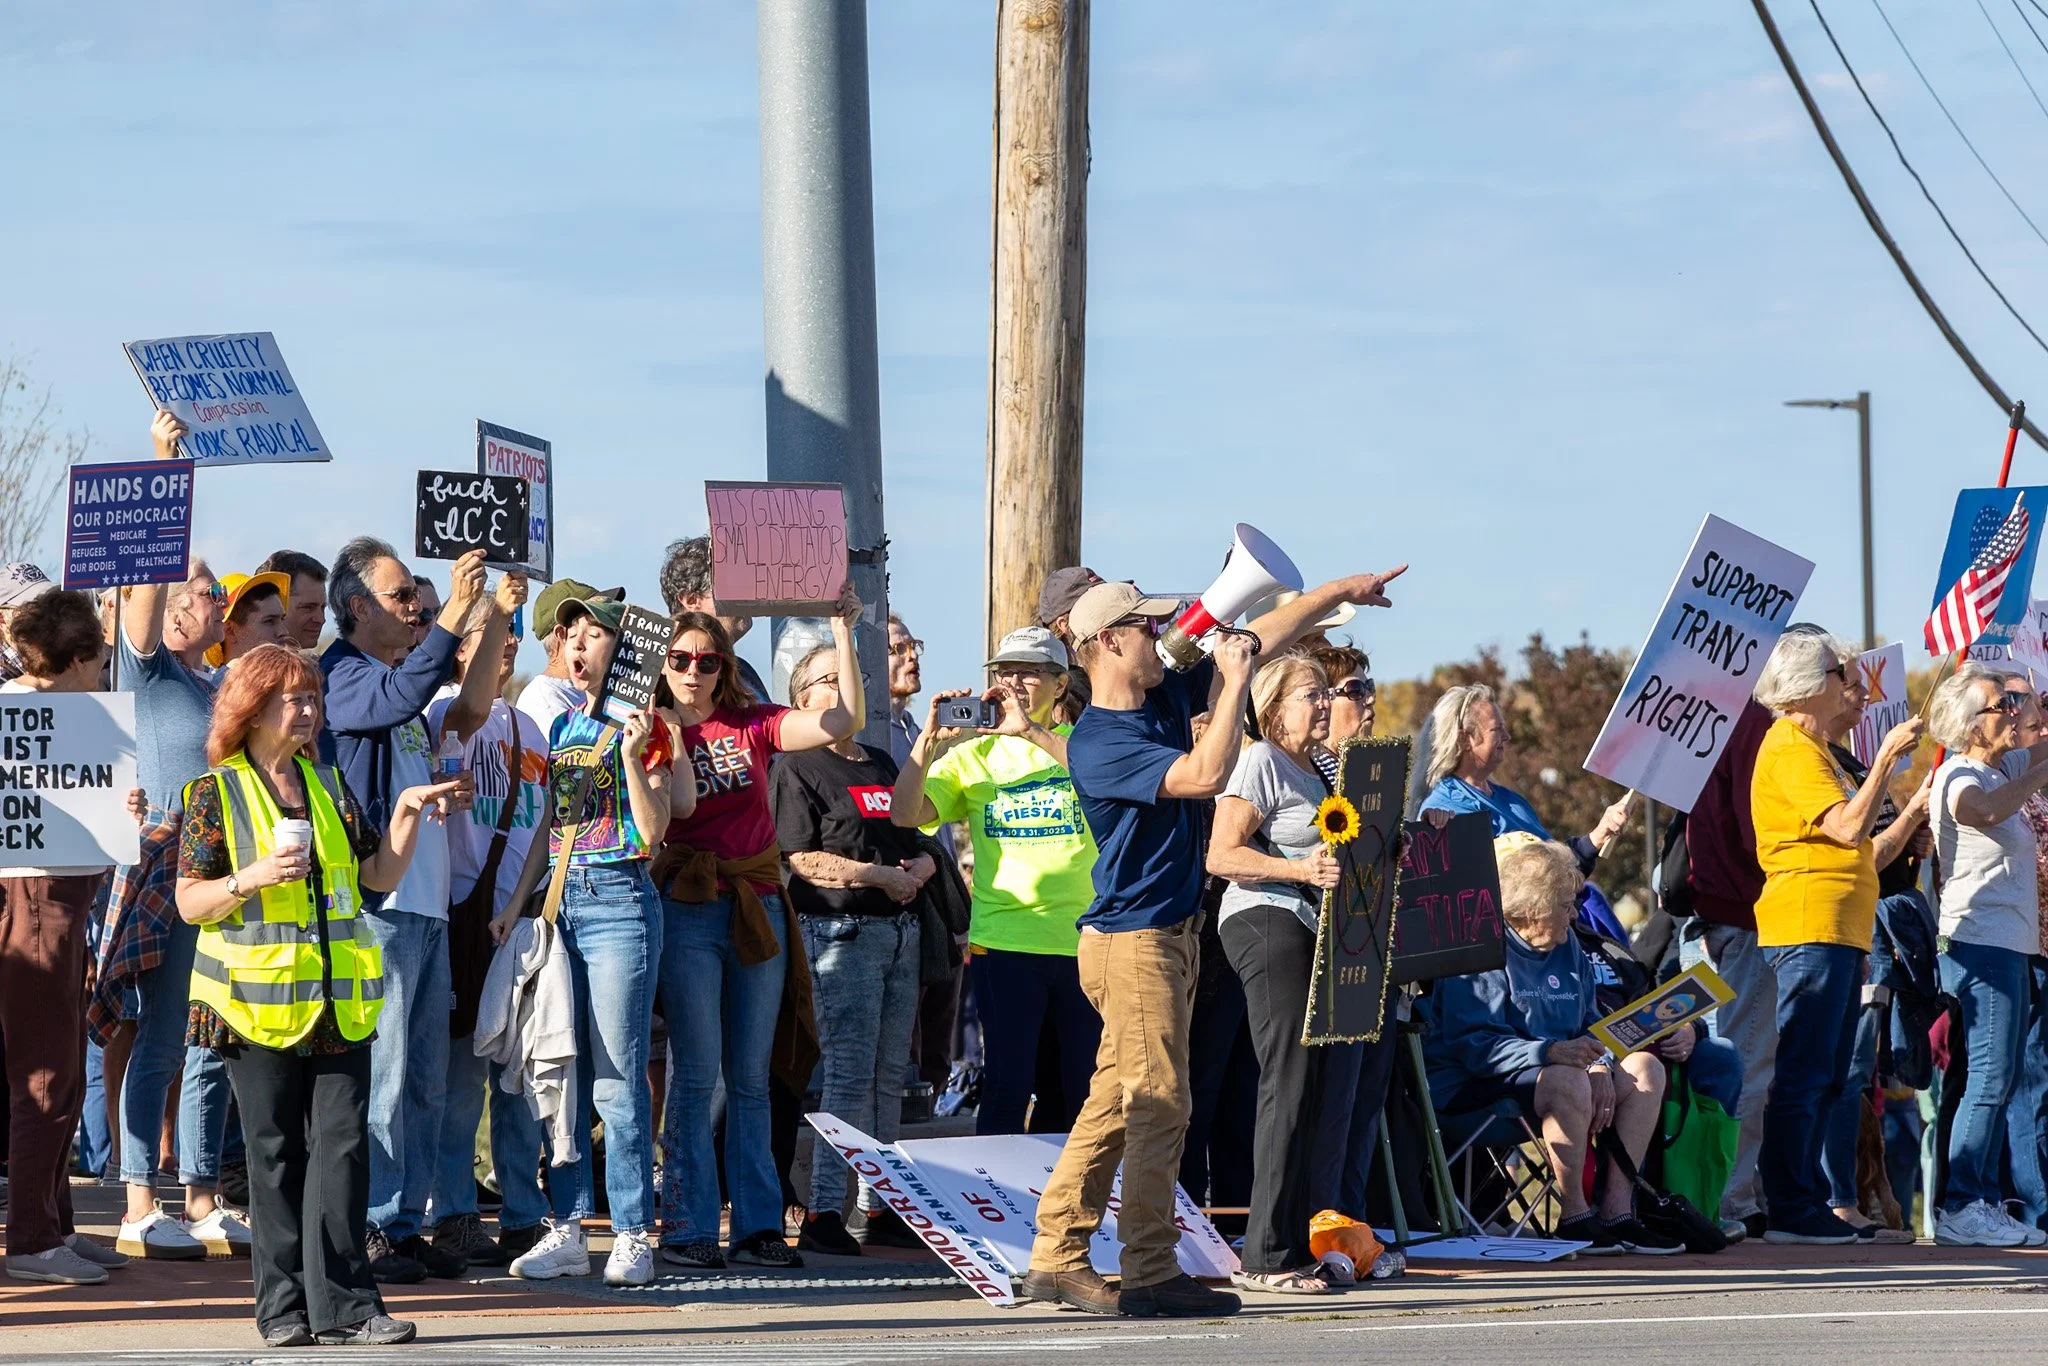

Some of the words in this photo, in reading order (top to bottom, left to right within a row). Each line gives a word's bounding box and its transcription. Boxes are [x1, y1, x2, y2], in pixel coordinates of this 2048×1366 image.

[131, 342, 186, 372] WHEN
[186, 336, 266, 372] CRUELTY
[148, 372, 227, 403] BECOMES
[225, 369, 293, 397] NORMAL
[193, 398, 270, 423] Compassion
[180, 428, 239, 458] LOOKS
[237, 418, 319, 458] RADICAL
[487, 440, 546, 484] PATRIOTS
[74, 477, 143, 505] HANDS
[150, 473, 189, 499] OFF
[73, 512, 101, 527] OUR
[106, 505, 187, 526] DEMOCRACY
[751, 489, 826, 527] GIVING
[110, 529, 147, 541] MEDICARE
[434, 506, 508, 547] ICE
[528, 515, 546, 544] ACY
[72, 547, 107, 559] REFUGEES
[118, 544, 145, 555] SOCIAL
[147, 541, 183, 553] SECURITY
[715, 526, 767, 566] SMALL
[769, 525, 844, 566] DICTATOR
[70, 563, 87, 573] OUR
[88, 561, 116, 573] BODIES
[135, 555, 182, 568] HEALTHCARE
[755, 564, 833, 600] ENERGY
[1691, 550, 1795, 622] SUPPORT
[628, 612, 671, 638] TRANS
[622, 630, 667, 656] RIGHTS
[1670, 602, 1759, 677] TRANS
[618, 647, 645, 665] ARE
[611, 662, 652, 687] HUMAN
[607, 677, 650, 705] RIGHTS
[0, 706, 55, 732] TOR
[1625, 674, 1729, 759] RIGHTS
[4, 735, 52, 760] IST
[693, 735, 741, 761] AKE
[0, 763, 113, 790] MERICAN
[692, 748, 753, 777] REET
[1370, 762, 1382, 782] NO
[696, 768, 753, 797] DIVE
[3, 794, 42, 820] ON
[1003, 807, 1062, 822] FIESTA
[1006, 828, 1017, 837] 30
[1020, 828, 1026, 836] &
[1043, 826, 1066, 836] 2025
[1396, 888, 1500, 948] TIFA
[1340, 965, 1368, 986] EVER
[974, 1166, 1022, 1215] PEOPLE
[1175, 1186, 1199, 1216] PEO
[833, 1143, 1007, 1299] DEMOCRACY
[875, 1146, 1007, 1275] GOVERNMENT
[960, 1191, 1006, 1223] OF
